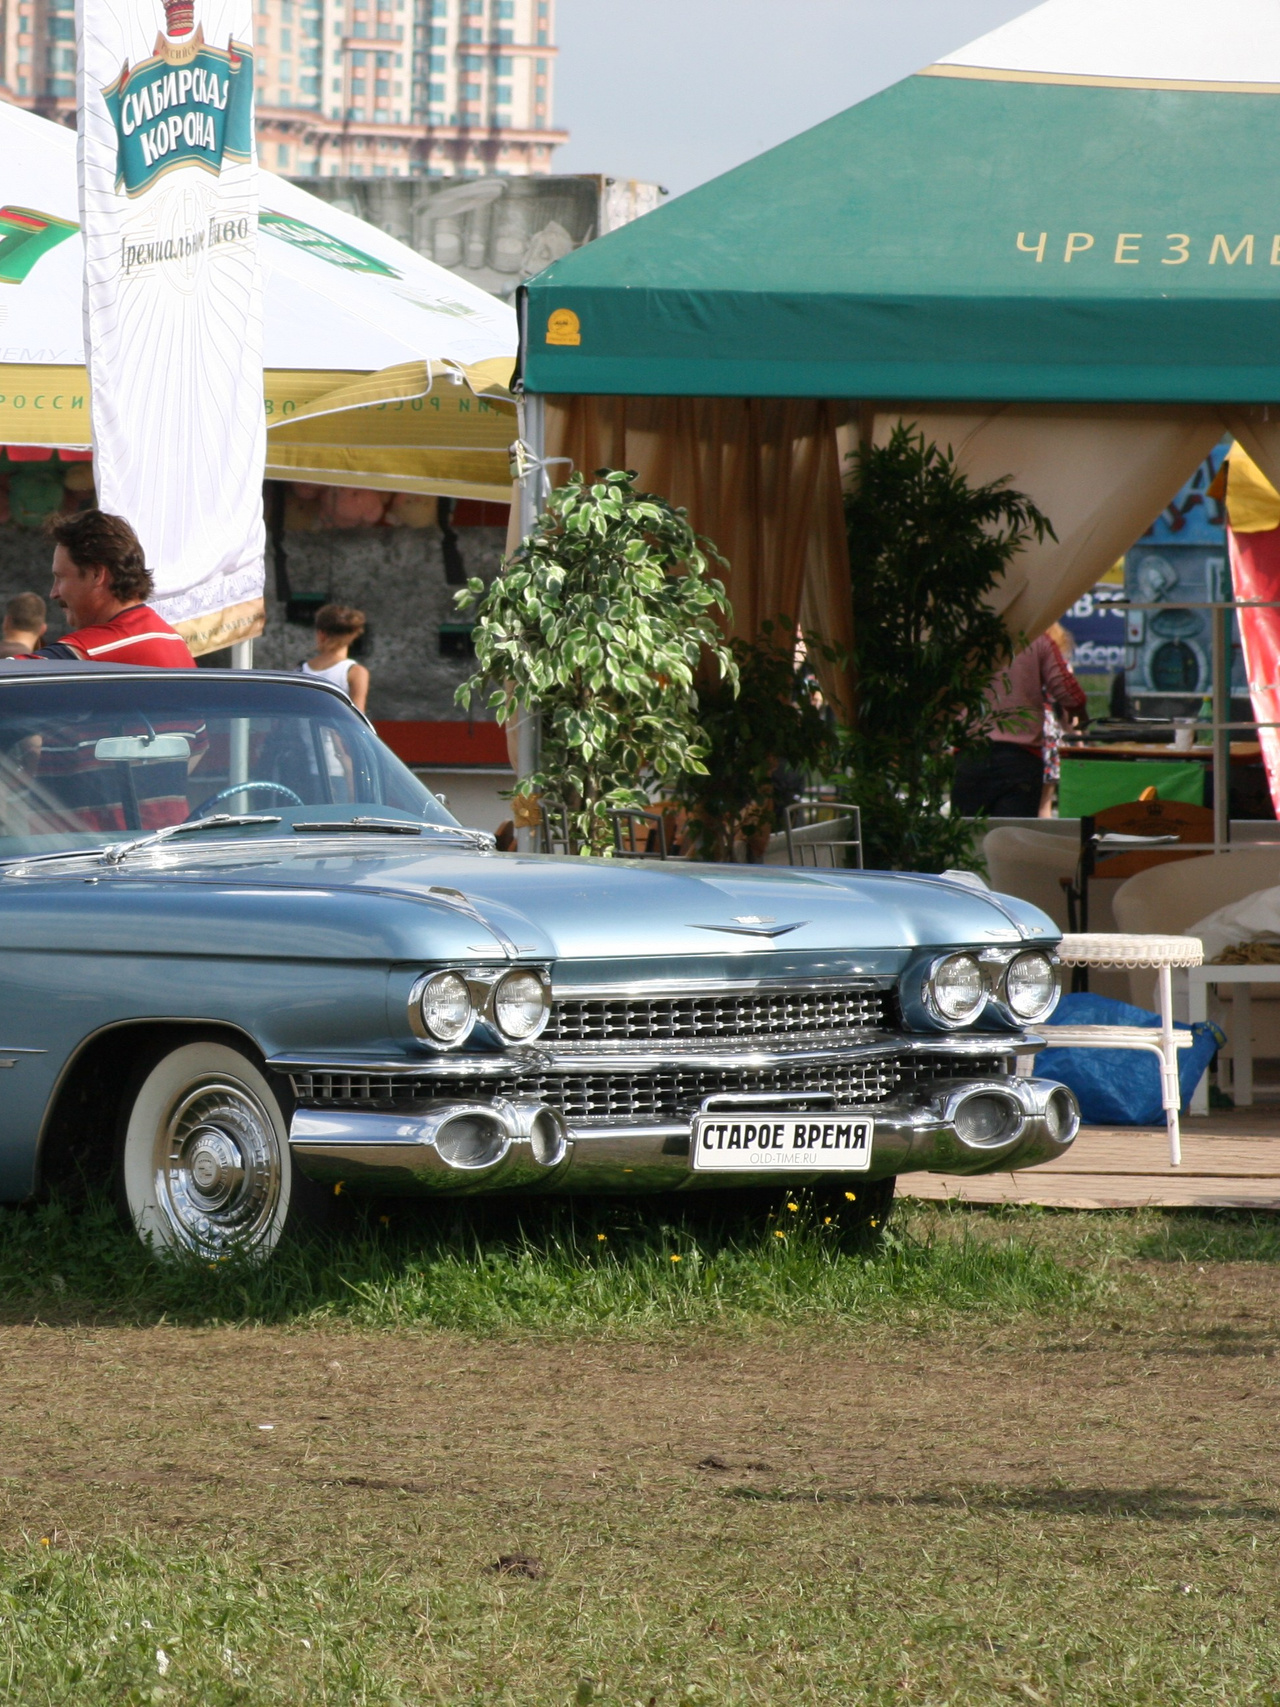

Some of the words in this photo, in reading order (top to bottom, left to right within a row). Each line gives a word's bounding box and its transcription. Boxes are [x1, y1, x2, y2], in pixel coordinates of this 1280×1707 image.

[139, 111, 216, 167] КОРОНА
[703, 1124, 784, 1149] СТАРОЕ
[792, 1124, 867, 1149] ВРЕМЯ
[749, 1153, 817, 1164] OLD-TIME.RU
